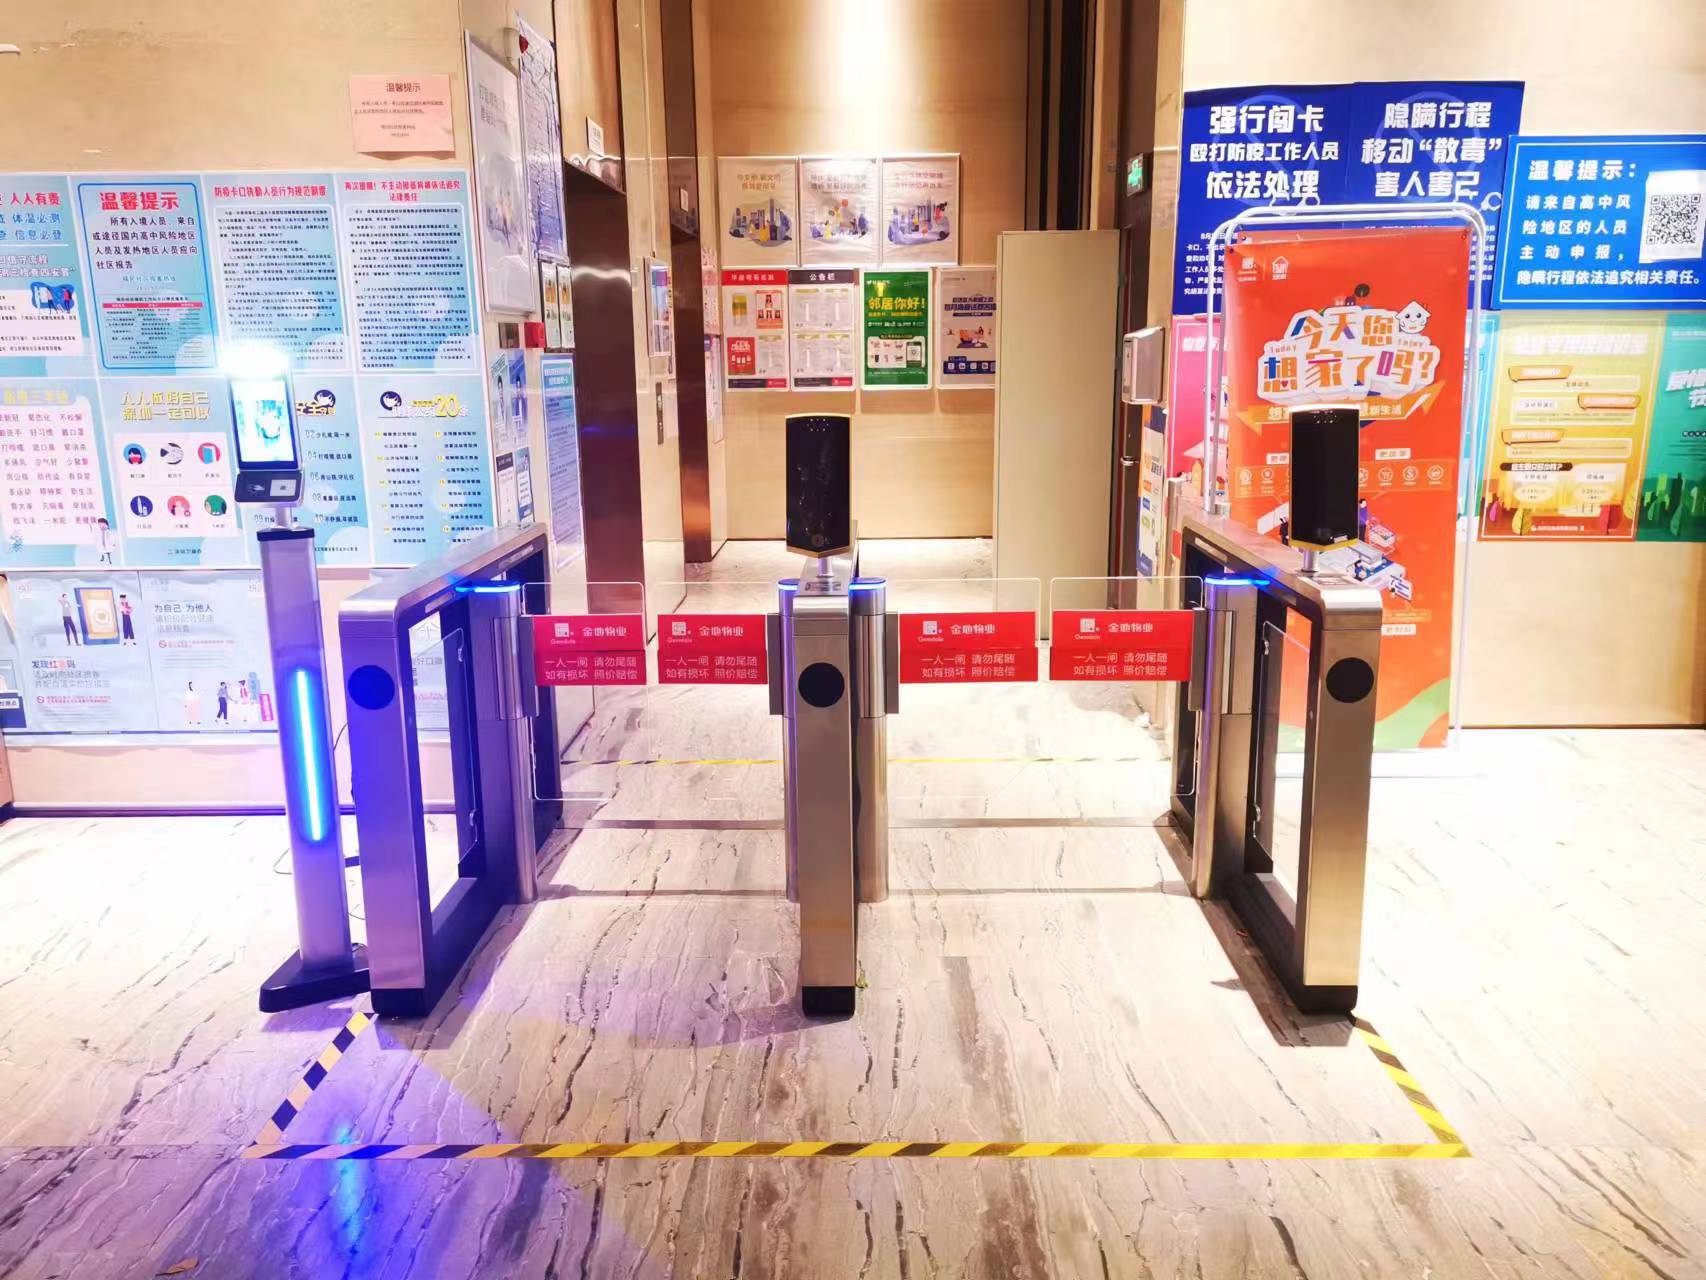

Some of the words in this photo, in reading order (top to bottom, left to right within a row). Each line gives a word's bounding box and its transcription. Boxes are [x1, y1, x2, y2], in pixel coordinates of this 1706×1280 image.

[386, 83, 421, 92] 温馨提示
[1209, 105, 1324, 134] 强行闯卡
[1384, 101, 1492, 129] 隐瞒行程
[1190, 141, 1339, 163] 殴打防疫工作人员
[1528, 160, 1636, 181] 温馨提示：
[1206, 170, 1320, 199] 依法处理
[1374, 171, 1480, 197] 害人害己
[10, 191, 61, 206] 人人有责
[214, 186, 327, 198] 防疫卡口执勤人员行为规范制度
[100, 191, 180, 211] 温馨提示
[1526, 195, 1631, 210] 请来自高中风
[110, 216, 167, 227] 所有入境人员
[1522, 220, 1627, 235] 险地区的人员
[92, 232, 197, 241] 或途径国内高中风险地区
[95, 247, 199, 256] 人员及发热地区人员应向
[96, 260, 134, 270] 社区报告
[1516, 270, 1700, 285] 隐瞒行程依法追究相关责任。
[869, 297, 925, 310] 邻居你好！
[1291, 311, 1393, 349] 今天您
[1263, 348, 1434, 393] 想家了吗？
[122, 392, 209, 405] 人人做好自己
[122, 407, 210, 421] 深圳一定可以
[155, 604, 182, 613] 为自己
[186, 604, 213, 613] 为他人
[582, 627, 627, 637] 金地物业
[699, 627, 744, 637] 金地物业
[950, 624, 996, 635] 金地物业
[1108, 622, 1153, 633] 金地物业
[544, 657, 588, 667] 一人一闸
[594, 657, 637, 667] 请勿尾随
[665, 656, 709, 667] 一人一闸
[715, 656, 758, 667] 请勿尾随
[921, 654, 966, 666] 一人一闸
[972, 653, 1015, 665] 请勿尾随
[1073, 653, 1117, 664] 一人一闸
[1124, 652, 1168, 664] 请勿尾随
[544, 669, 588, 680] 如有损坏
[594, 669, 638, 680] 照价赔偿
[666, 669, 710, 680] 如有损坏
[715, 669, 758, 680] 照价赔偿
[922, 667, 966, 679] 如有损坏
[972, 666, 1016, 678] 照价赔偿
[1073, 665, 1117, 677] 如有损坏
[1123, 665, 1167, 677] 照价赔偿
